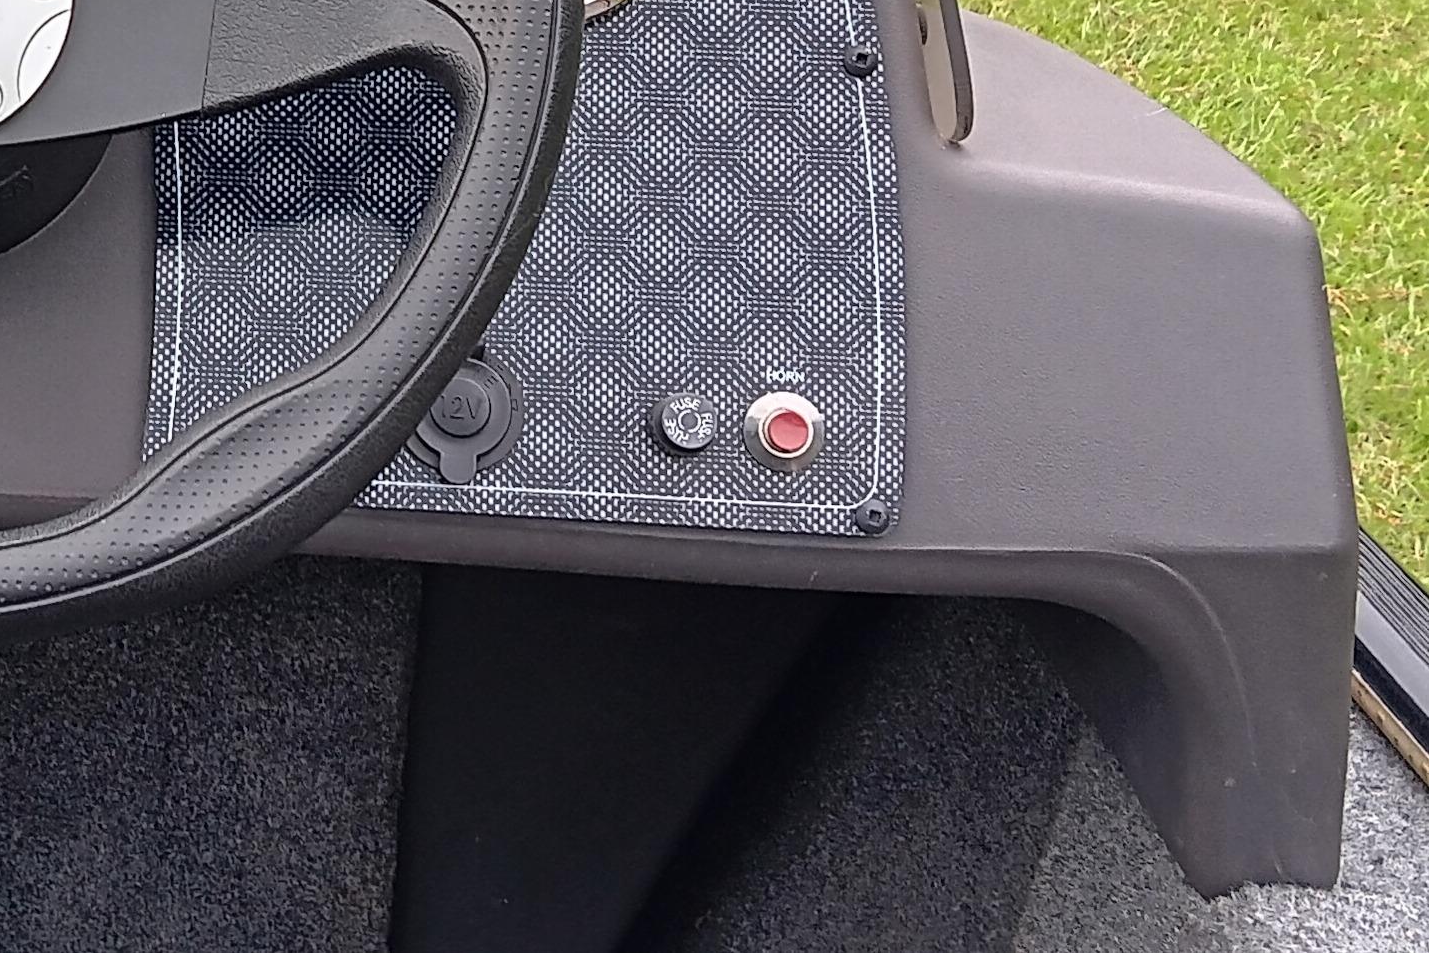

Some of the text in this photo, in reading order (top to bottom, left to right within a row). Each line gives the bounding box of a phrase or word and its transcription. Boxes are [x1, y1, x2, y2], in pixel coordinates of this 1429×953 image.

[766, 368, 805, 384] HORN
[439, 393, 482, 420] 12V
[670, 397, 701, 414] FUSE
